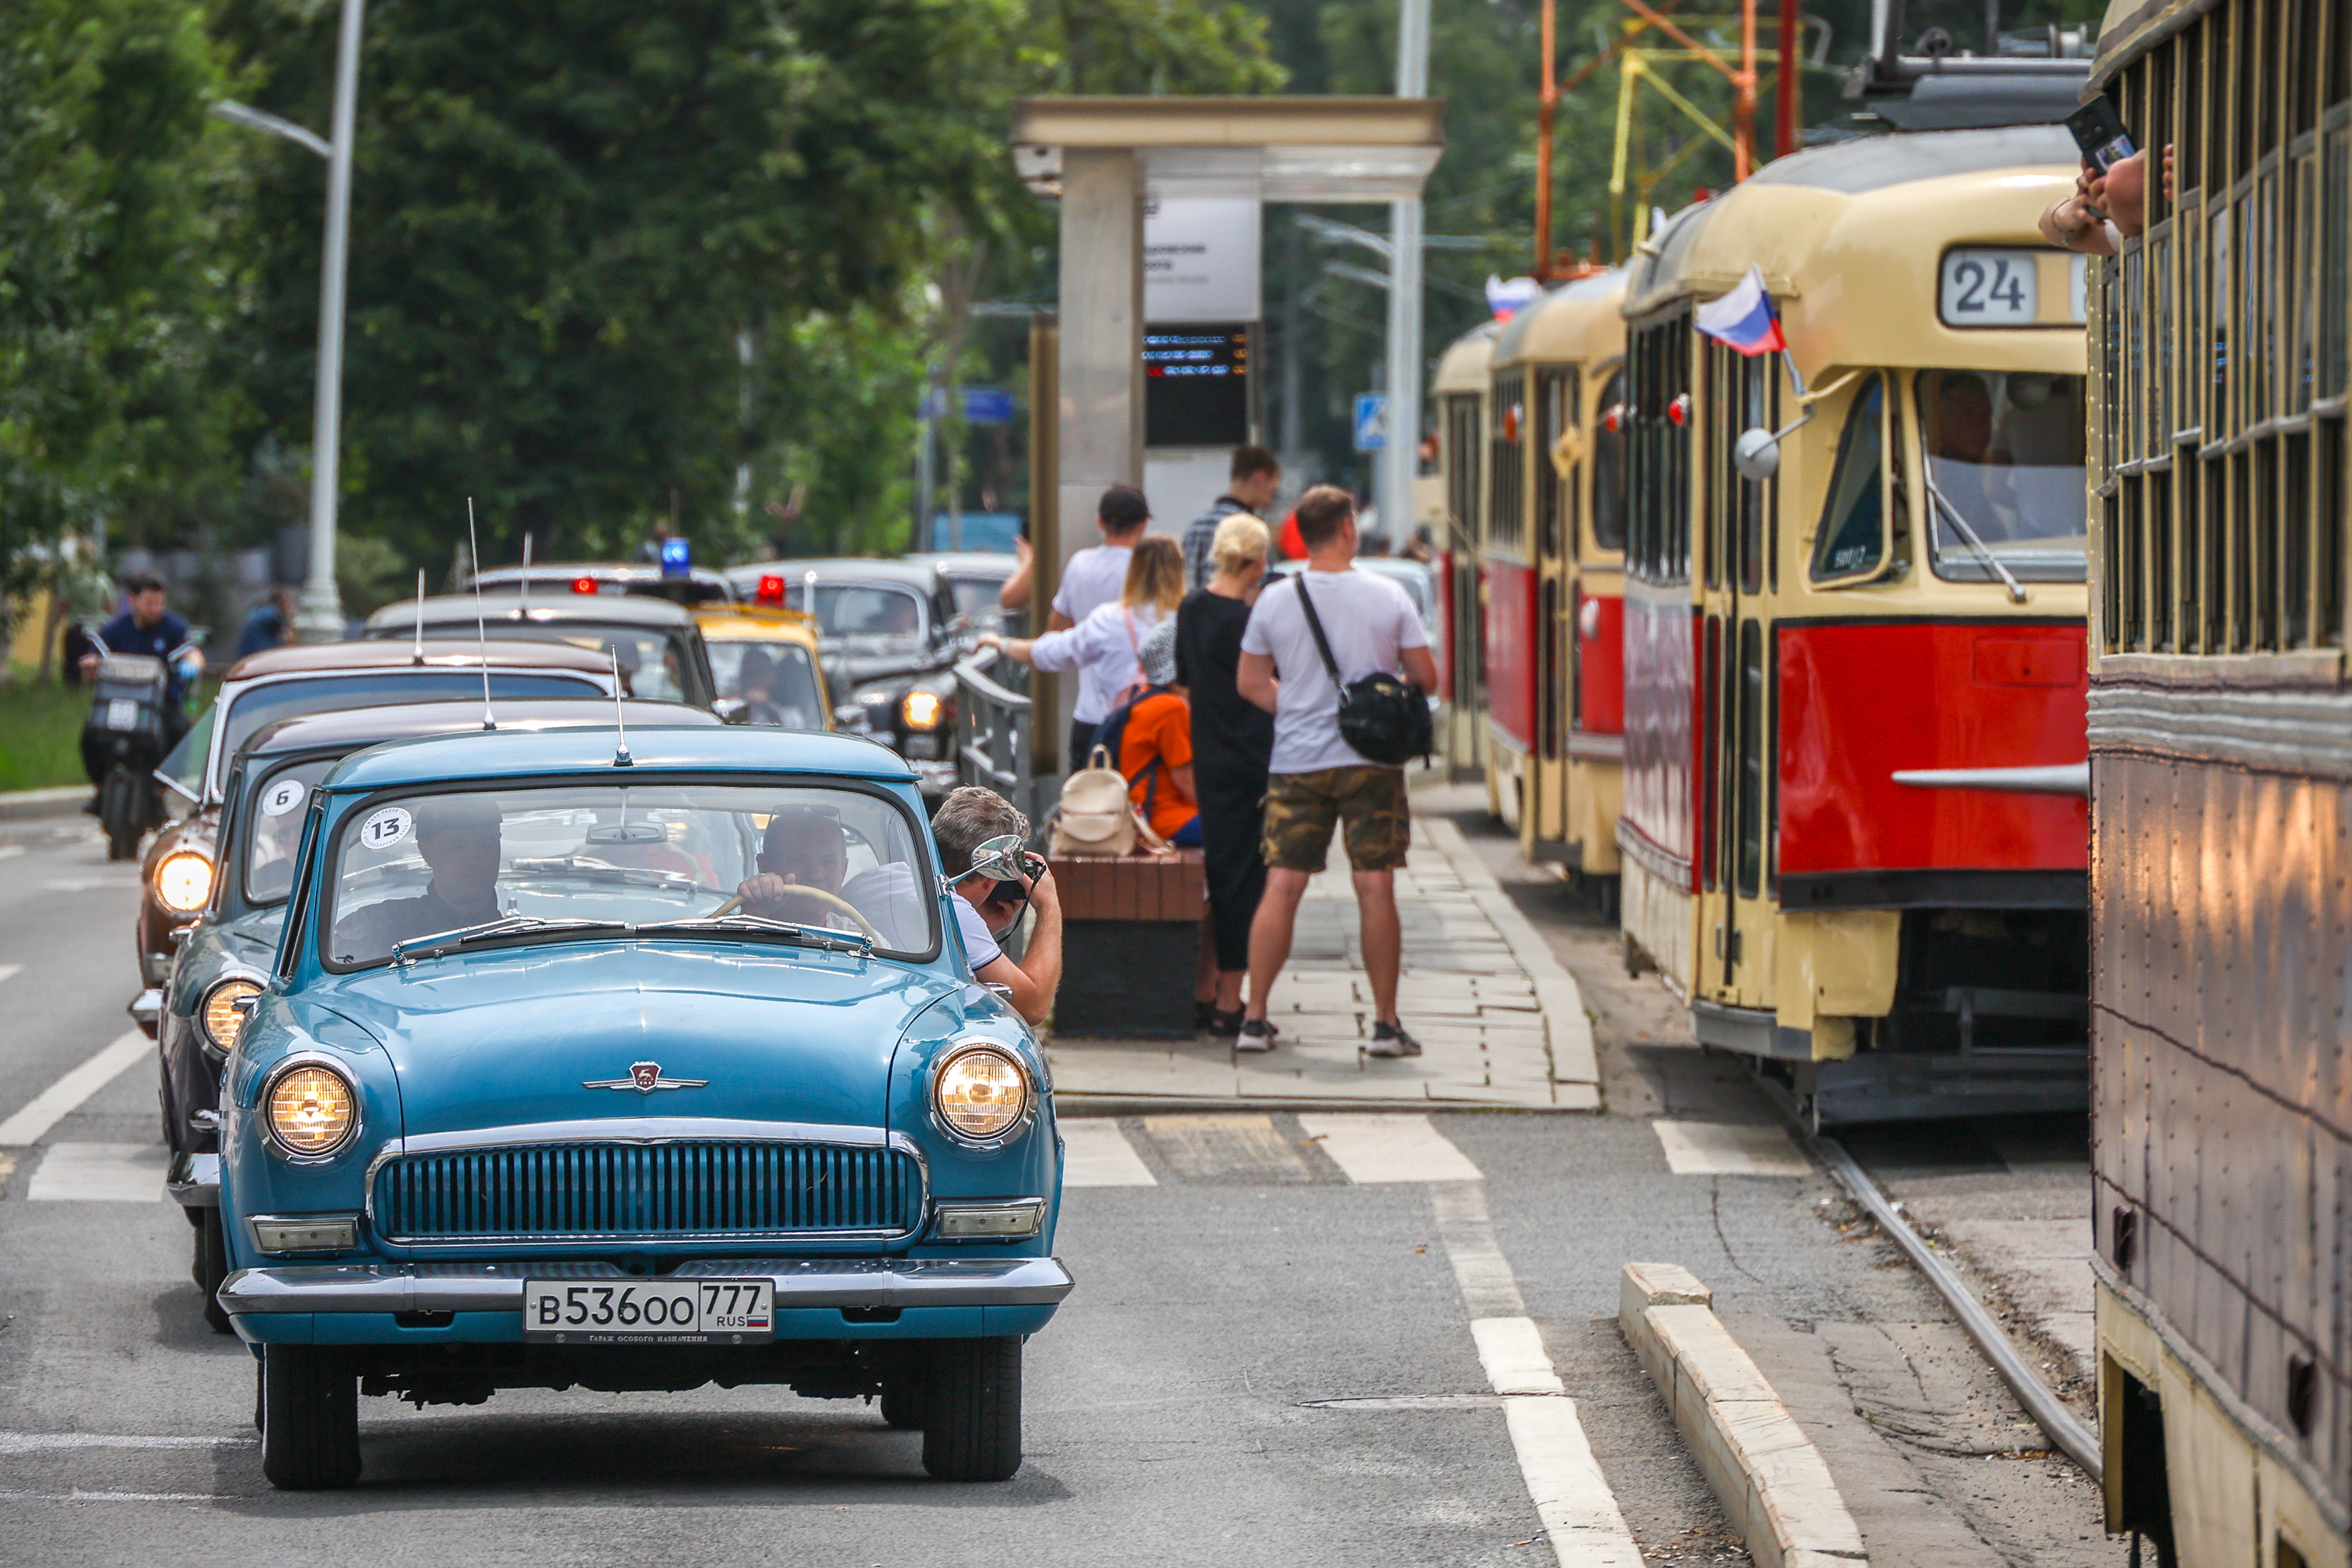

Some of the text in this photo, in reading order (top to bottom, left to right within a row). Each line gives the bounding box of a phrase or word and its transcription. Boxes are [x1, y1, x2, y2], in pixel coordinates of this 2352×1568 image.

[1953, 259, 2025, 312] 24
[276, 789, 290, 806] 6
[371, 817, 400, 840] 13
[702, 1285, 761, 1315] 777
[717, 1316, 746, 1327] RUS
